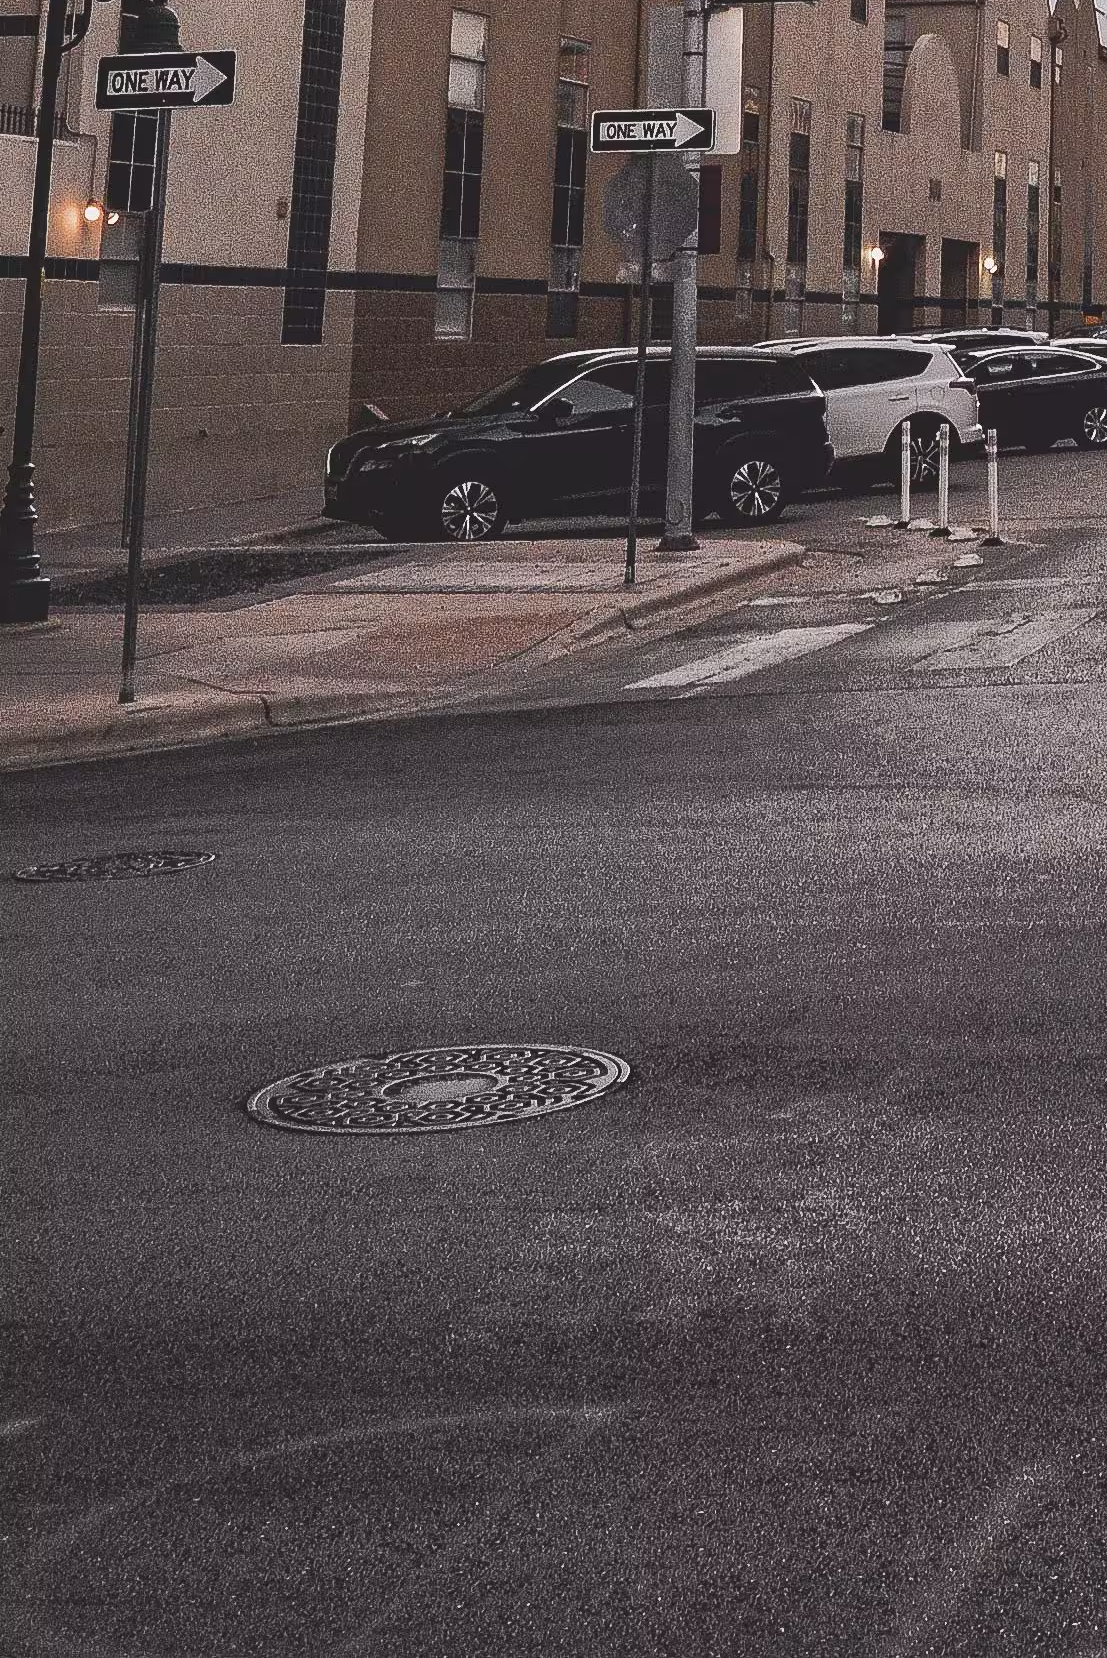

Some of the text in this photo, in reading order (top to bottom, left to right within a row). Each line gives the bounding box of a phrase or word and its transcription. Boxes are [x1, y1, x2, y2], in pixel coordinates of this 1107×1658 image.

[111, 68, 196, 94] ONE WAY
[606, 121, 678, 140] ONE WAY
